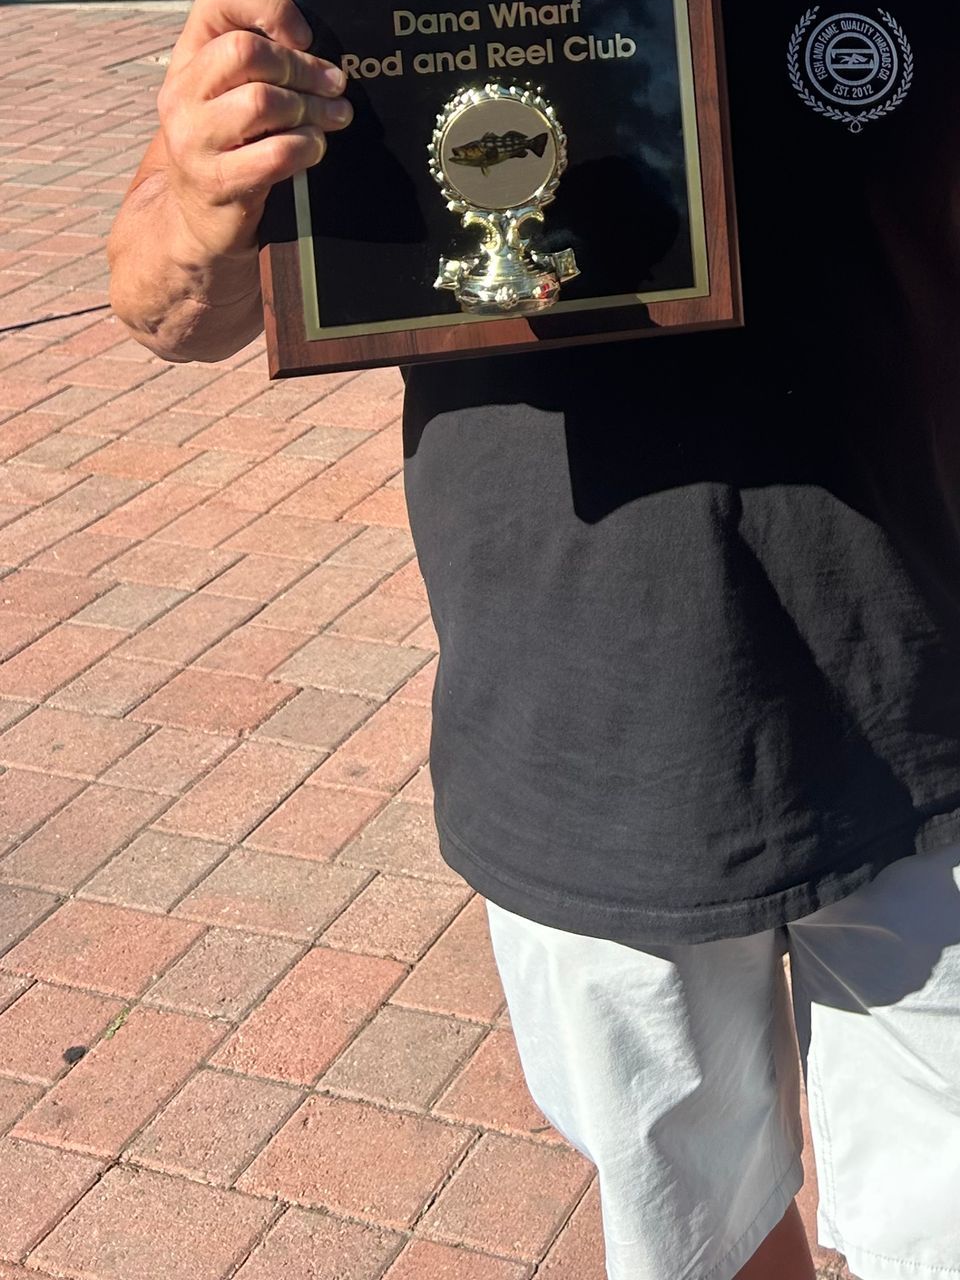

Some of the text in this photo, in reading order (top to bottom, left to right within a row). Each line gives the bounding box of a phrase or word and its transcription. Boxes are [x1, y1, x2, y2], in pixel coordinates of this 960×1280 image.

[394, 11, 481, 37] Dana
[817, 23, 839, 44] FAME
[840, 20, 874, 36] QUALITY
[341, 33, 637, 79] Rod and Reel Club
[812, 42, 825, 60] AND
[872, 32, 891, 68] THREADS
[813, 61, 828, 80] FISH
[832, 83, 874, 98] EST. 2012
